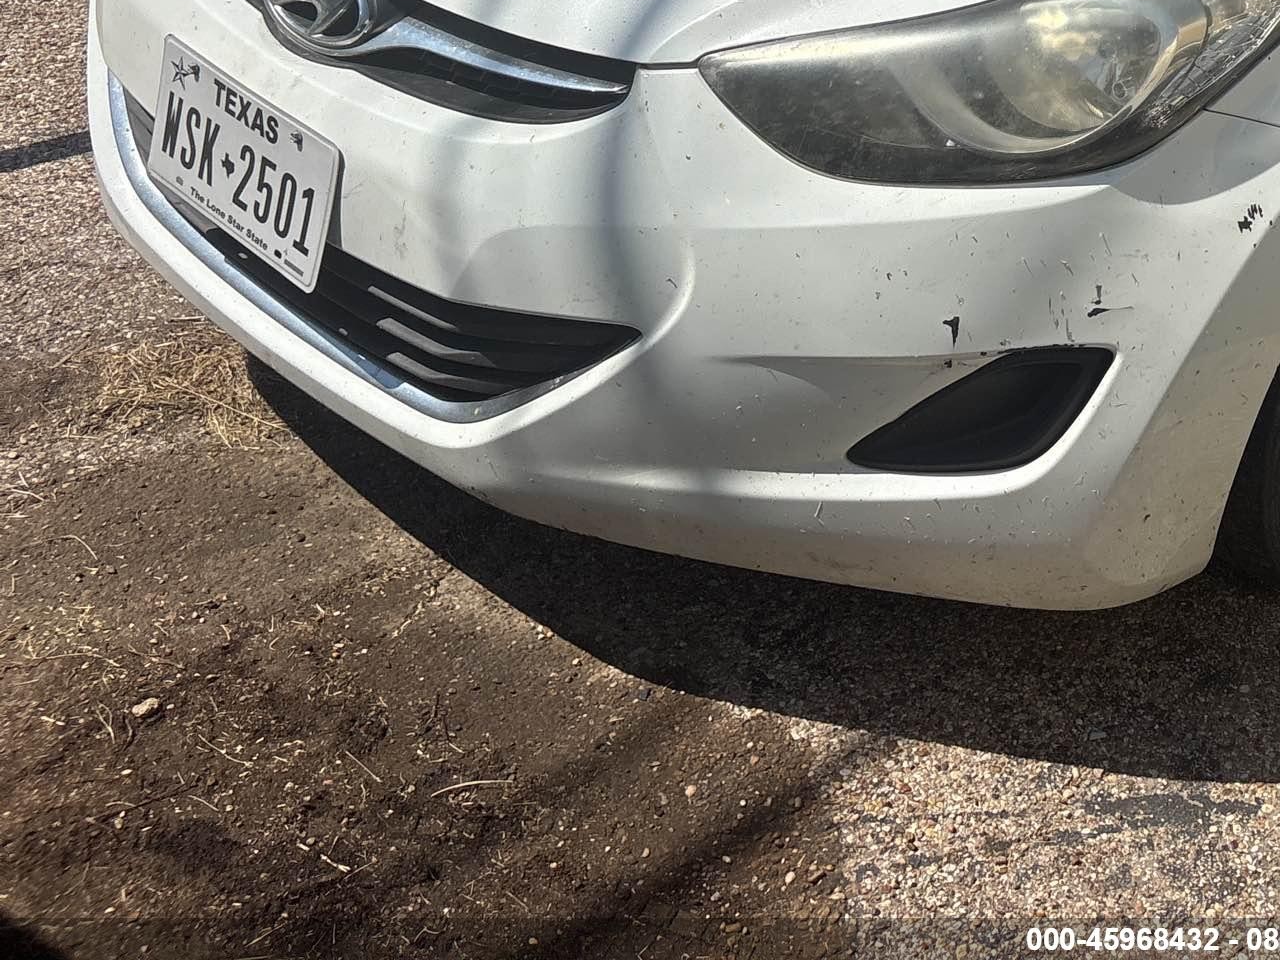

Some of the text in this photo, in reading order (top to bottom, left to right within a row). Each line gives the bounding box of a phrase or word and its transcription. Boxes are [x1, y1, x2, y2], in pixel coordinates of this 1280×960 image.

[213, 77, 279, 144] TEXAS
[161, 90, 316, 257] WSK 2501
[190, 186, 268, 251] The Lone Star State
